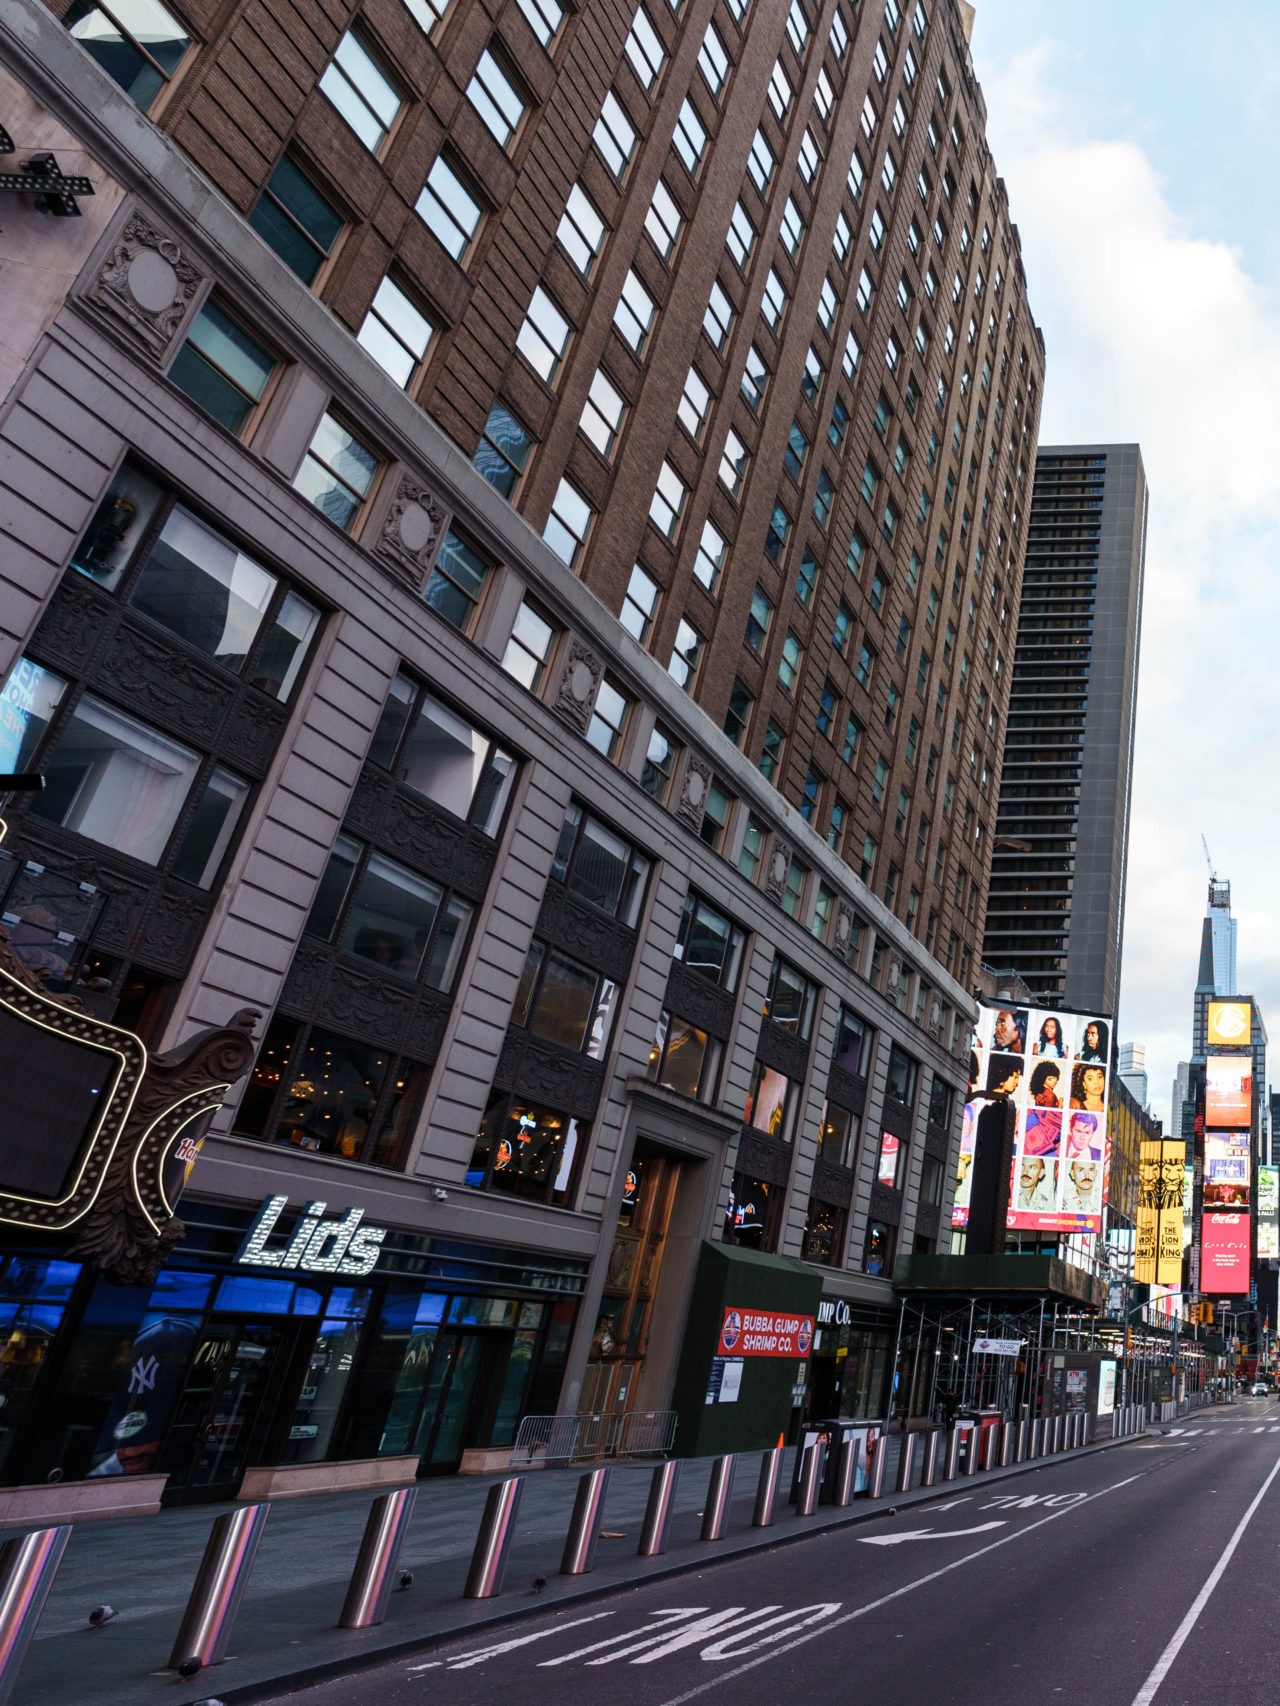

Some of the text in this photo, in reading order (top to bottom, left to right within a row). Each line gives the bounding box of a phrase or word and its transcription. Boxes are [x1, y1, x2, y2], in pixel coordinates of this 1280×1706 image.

[238, 1195, 388, 1276] Lids
[1161, 1234, 1179, 1246] LION
[1160, 1246, 1181, 1259] KING
[742, 1315, 799, 1334] BUBBA GUMP
[742, 1335, 793, 1352] SHRIMP CO.
